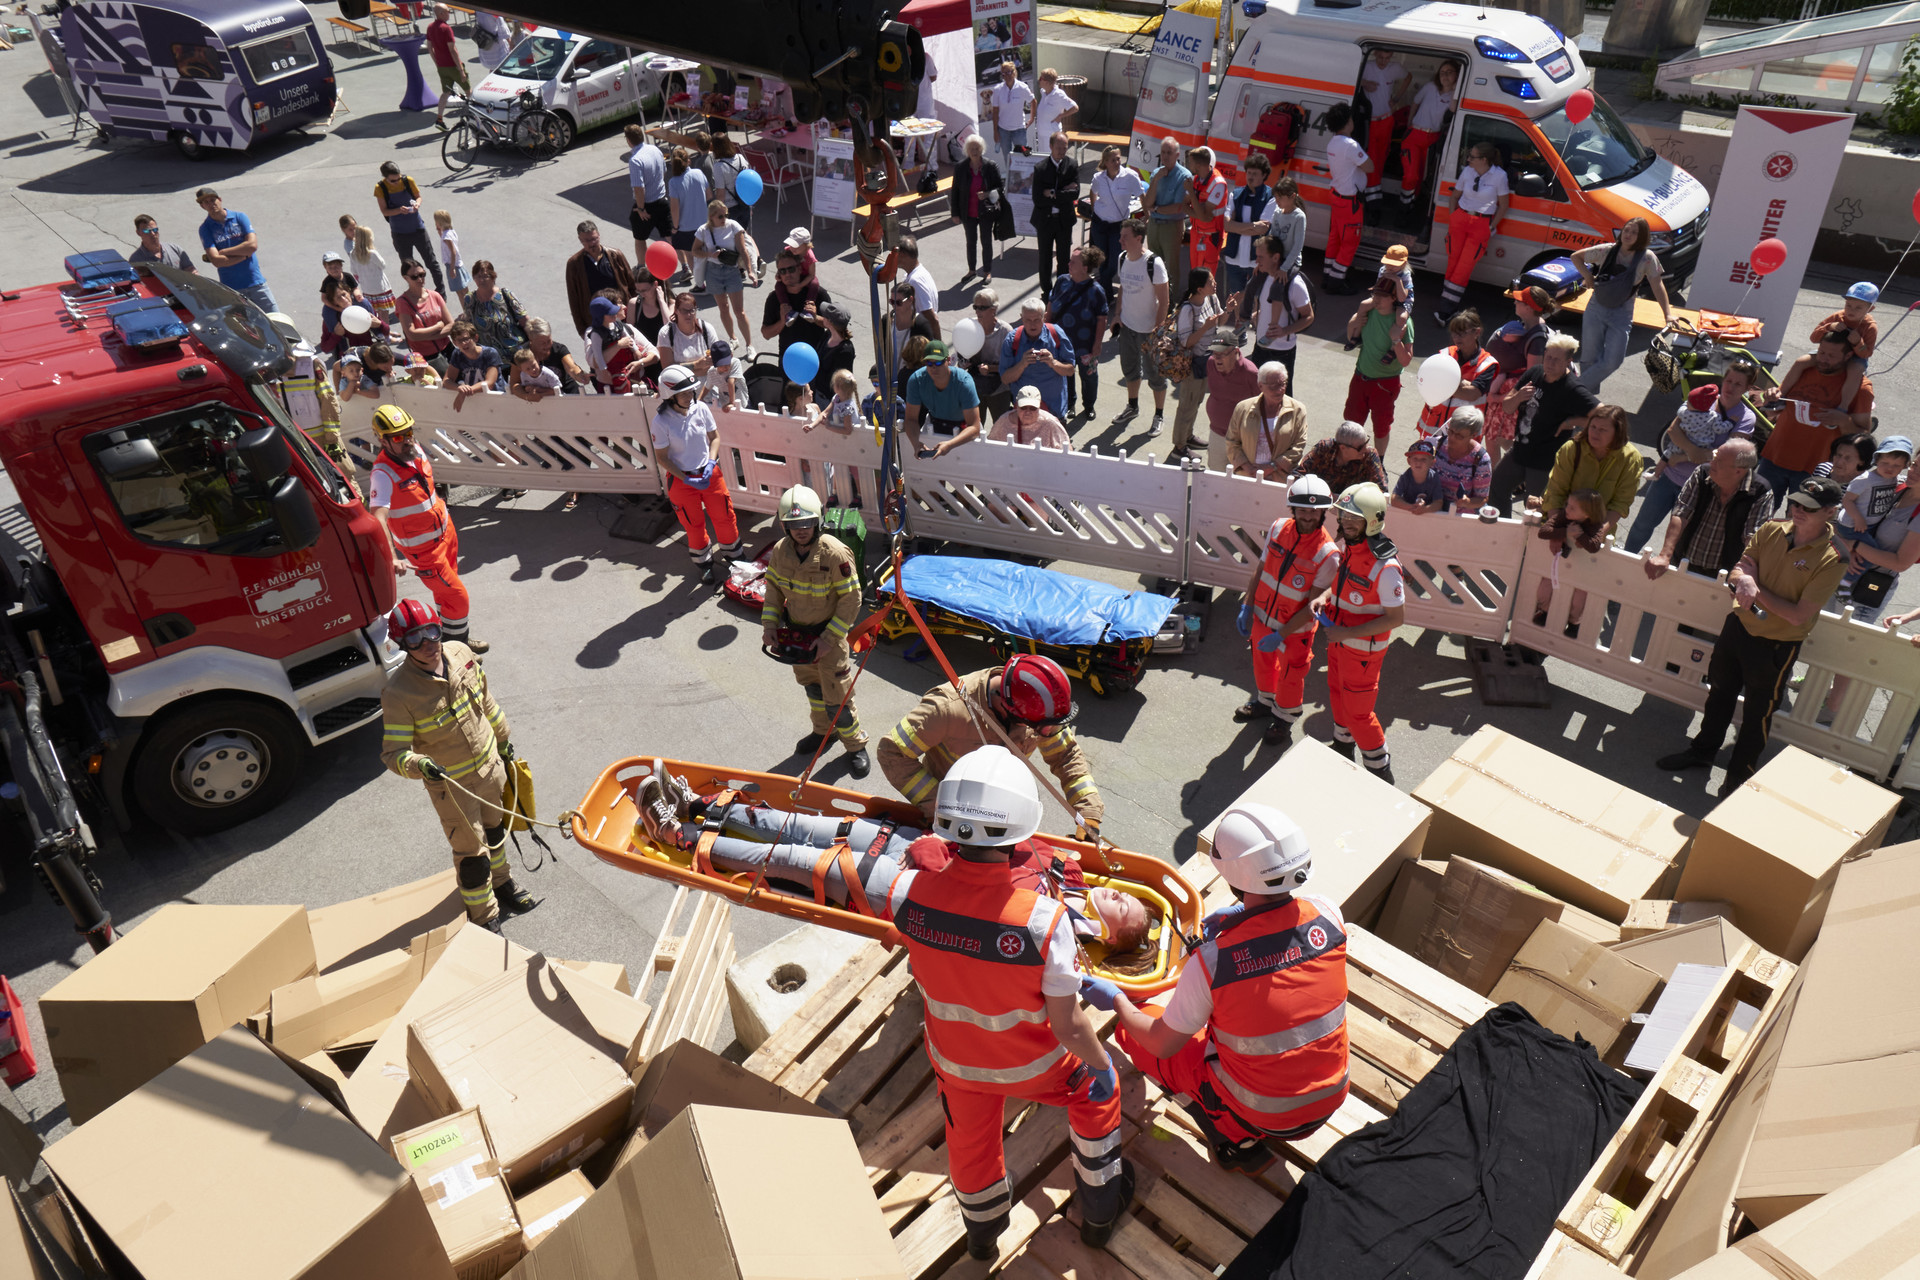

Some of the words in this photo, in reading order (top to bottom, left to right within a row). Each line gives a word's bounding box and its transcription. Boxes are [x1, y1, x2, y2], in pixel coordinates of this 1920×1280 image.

[975, 2, 1009, 12] JOHANNITER
[242, 15, 286, 33] hypotirol.com
[1175, 51, 1195, 64] TIROL
[279, 83, 309, 101] Unsere
[577, 90, 586, 98] DIE
[579, 90, 609, 106] JOHANNITER
[272, 91, 320, 118] Landesbank
[1643, 171, 1693, 210] AMBULANCE
[1729, 261, 1749, 283] DIE
[243, 583, 264, 595] F.F.
[267, 561, 321, 586] MÜHLAU
[255, 595, 333, 628] INNSBRUCK
[323, 617, 345, 630] 270
[966, 808, 1006, 819] RETTUNGSDIENST
[907, 907, 925, 925] DIE
[906, 922, 981, 953] JOHANNITER
[1232, 947, 1252, 963] DIE
[1235, 946, 1303, 975] JOHANNITER
[413, 1132, 459, 1159] VERZOLLT
